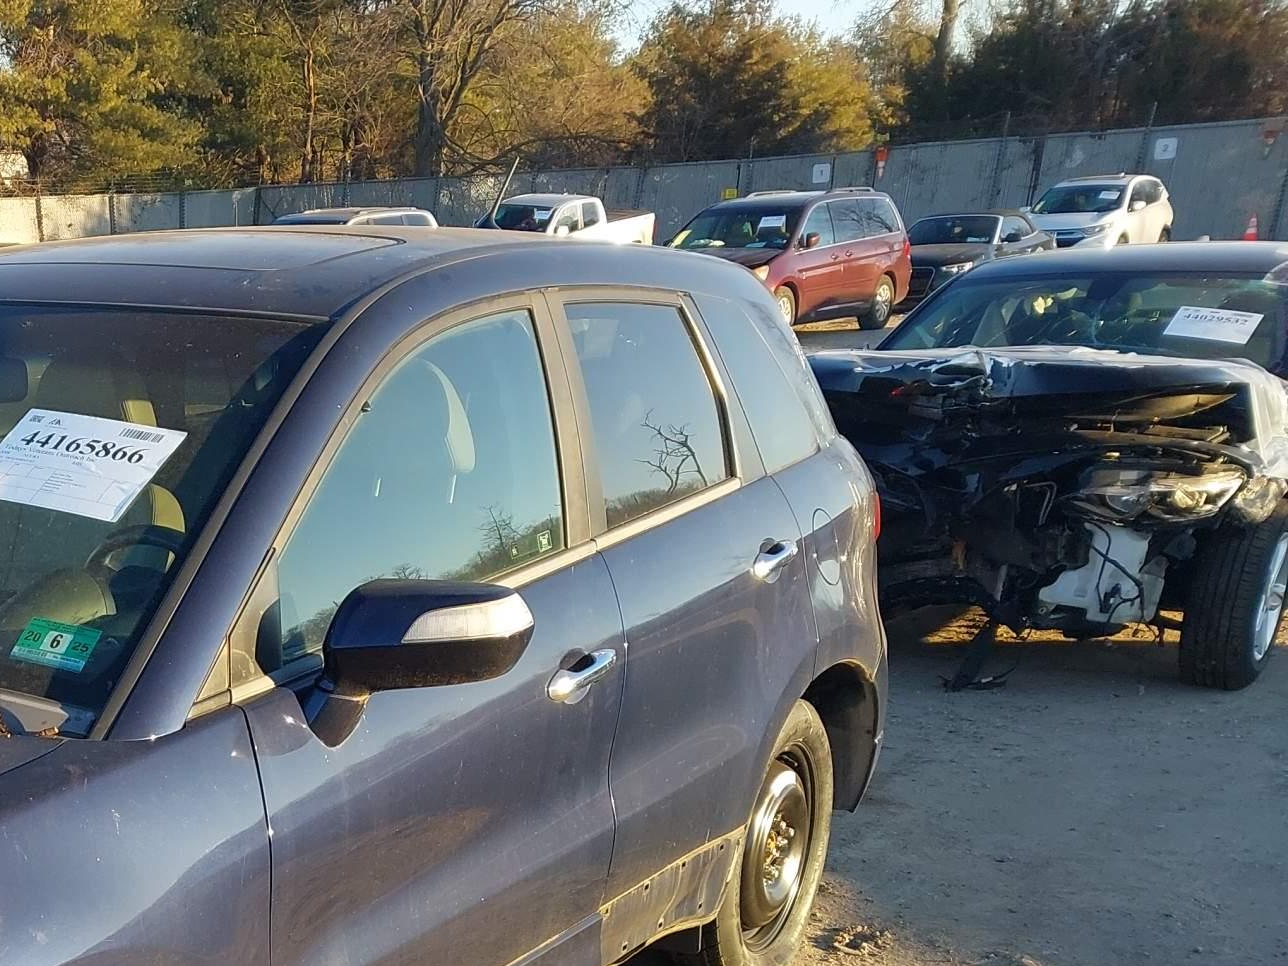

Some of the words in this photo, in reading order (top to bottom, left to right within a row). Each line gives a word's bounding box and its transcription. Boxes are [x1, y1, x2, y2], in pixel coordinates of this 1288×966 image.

[20, 430, 151, 464] 44165866
[24, 630, 41, 642] 20
[49, 633, 64, 649] 6
[71, 641, 90, 653] 25
